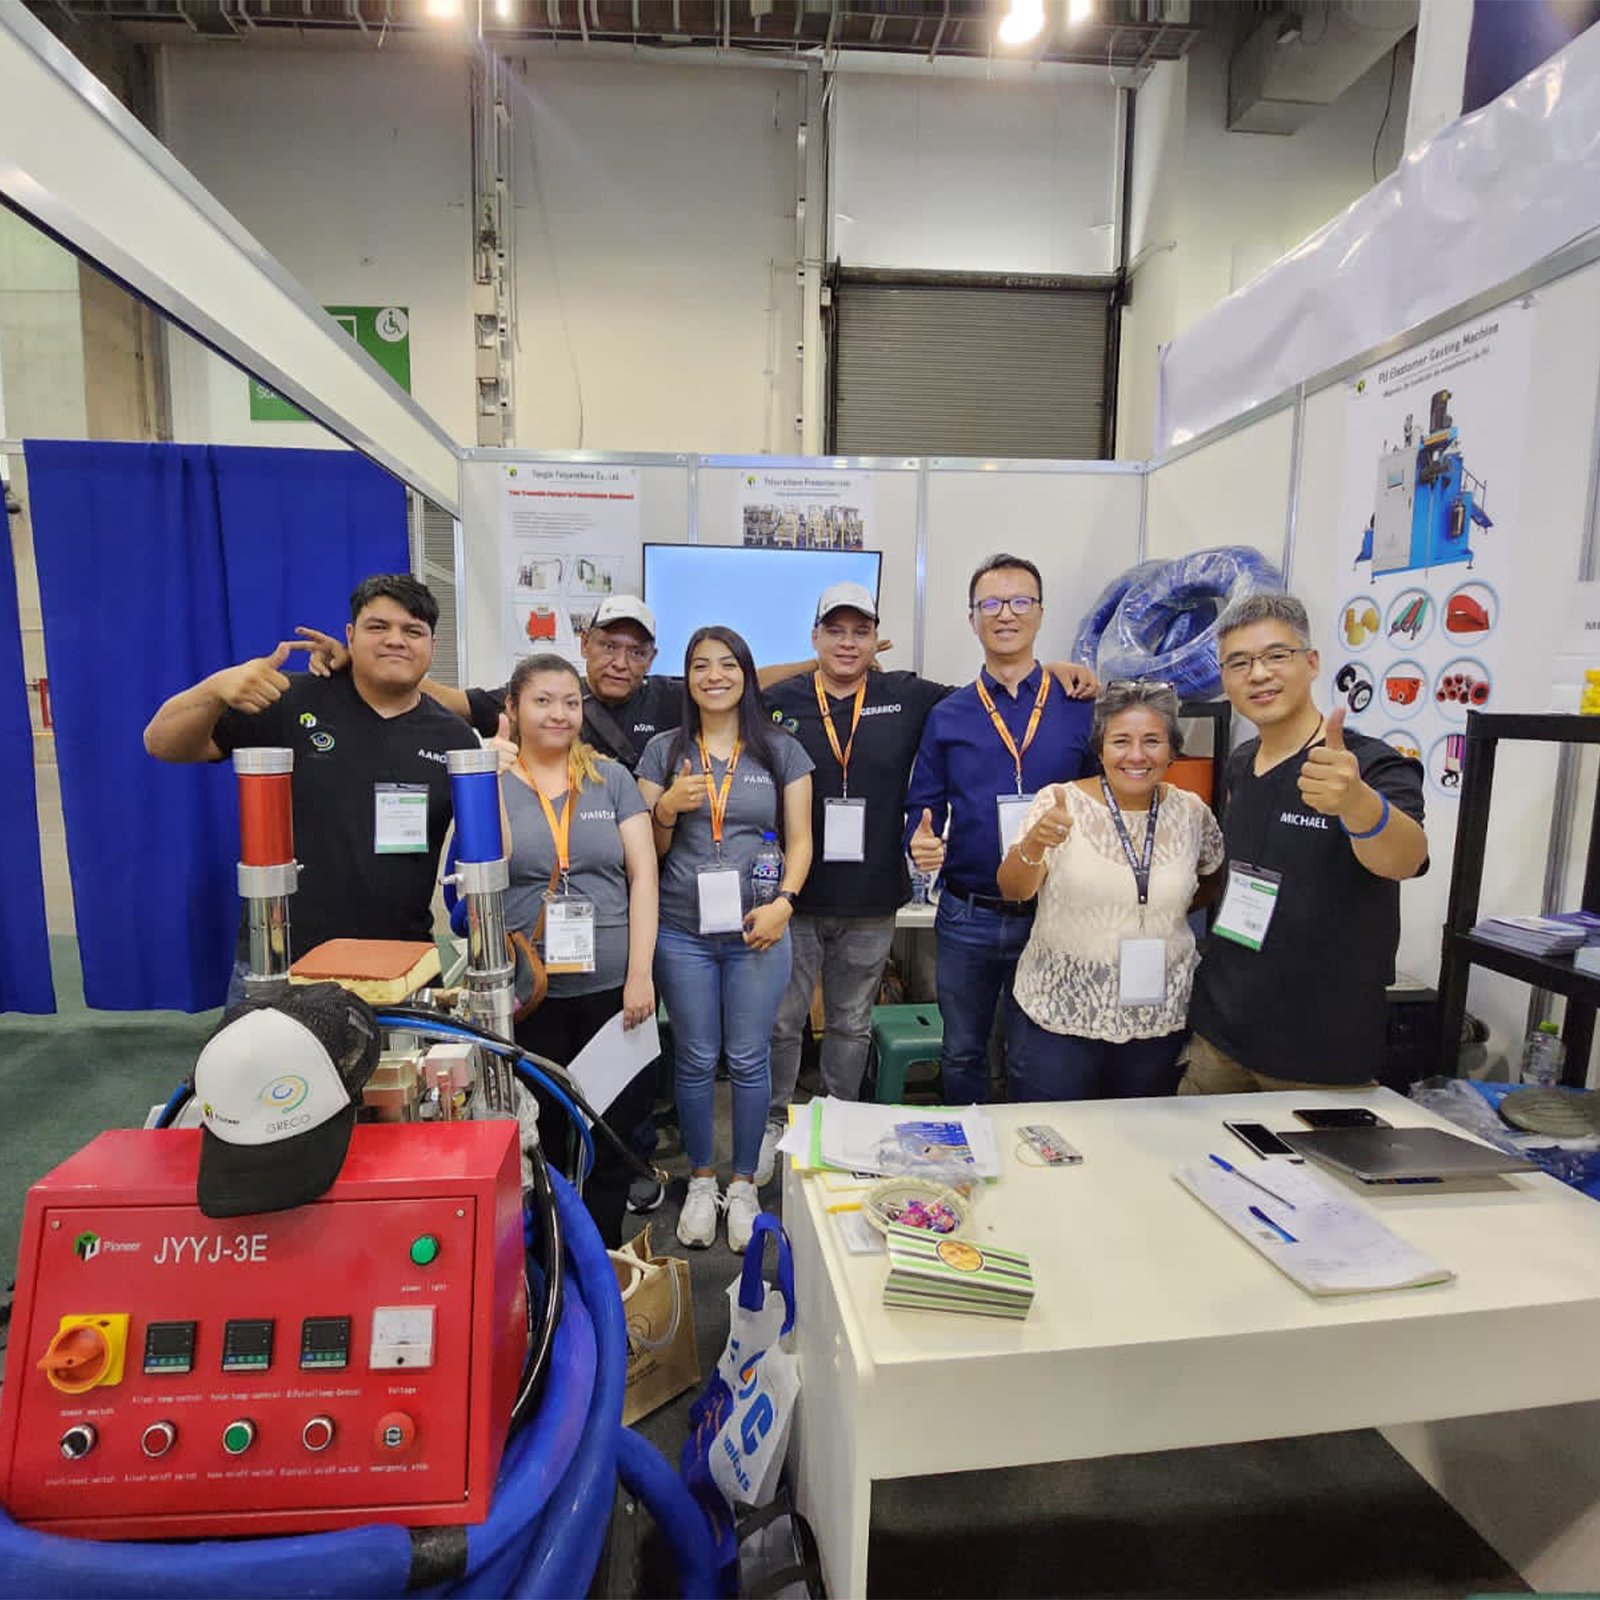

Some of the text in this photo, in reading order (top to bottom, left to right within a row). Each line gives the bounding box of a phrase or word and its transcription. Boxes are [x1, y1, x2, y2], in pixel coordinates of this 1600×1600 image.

[1280, 812, 1328, 830] MICHAEL
[266, 1113, 311, 1134] GRECO
[103, 1240, 141, 1252] Pioneer
[154, 1234, 269, 1264] JYYJ-3E
